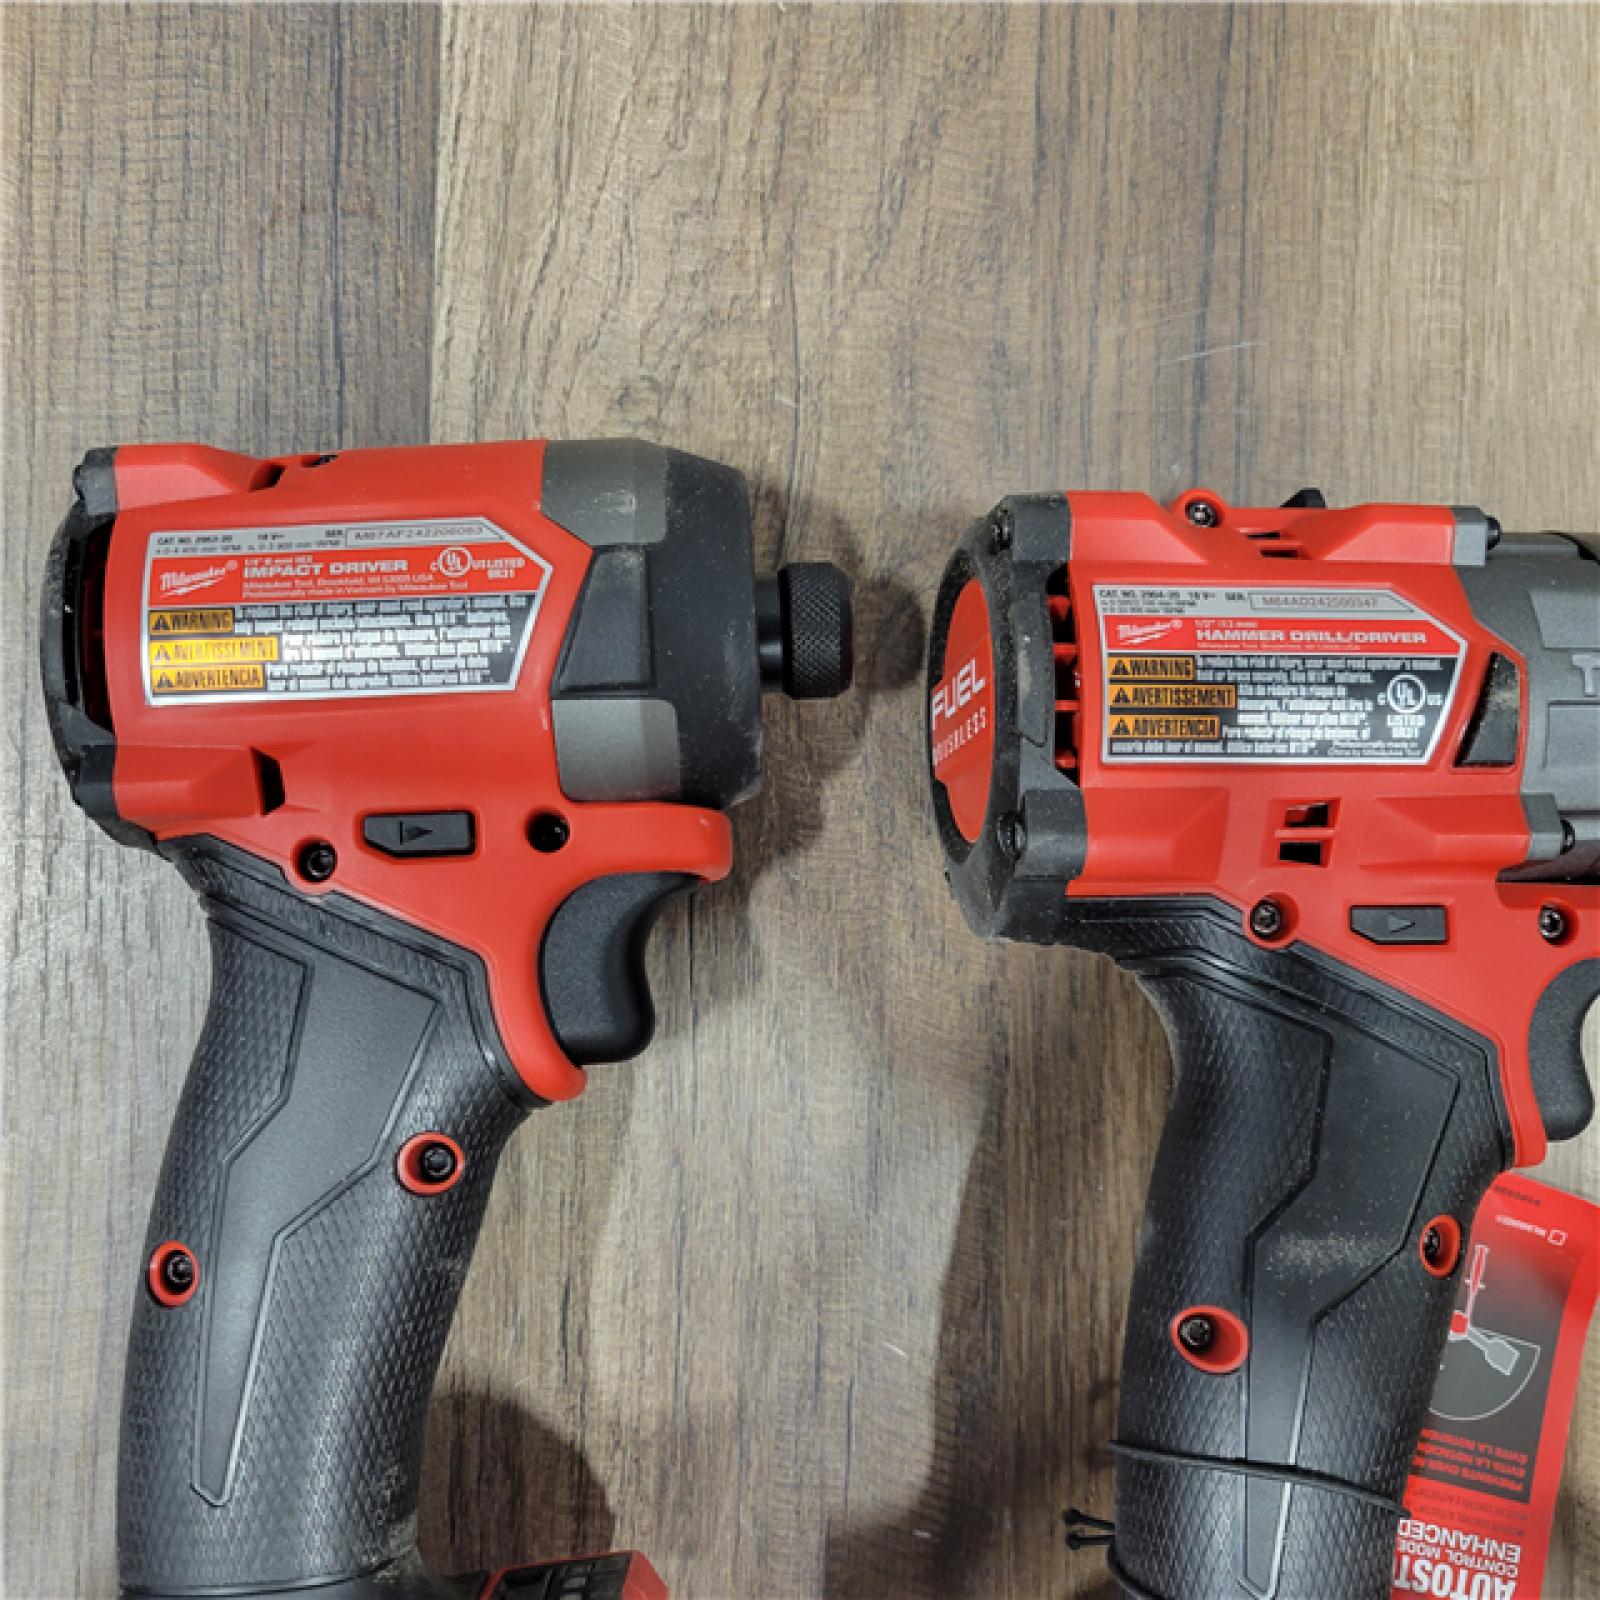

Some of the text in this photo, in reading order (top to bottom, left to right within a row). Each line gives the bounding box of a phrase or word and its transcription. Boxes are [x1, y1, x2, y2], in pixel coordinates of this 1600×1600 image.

[244, 560, 409, 579] IMPACT DRIVER
[169, 611, 231, 632] WARNING
[1196, 629, 1427, 644] HAMMER DRILL/DRIVER
[175, 667, 261, 689] ADVERTENCIA
[1130, 658, 1191, 677] WARNING
[931, 657, 986, 731] FUEL
[1132, 687, 1233, 706] AVERTISSEMENT
[1133, 718, 1217, 737] ADVERTENCIA
[1397, 1517, 1521, 1563] ENHANCED
[1397, 1538, 1519, 1577] CONTROL MODE
[1392, 1555, 1518, 1600] AUTOST
